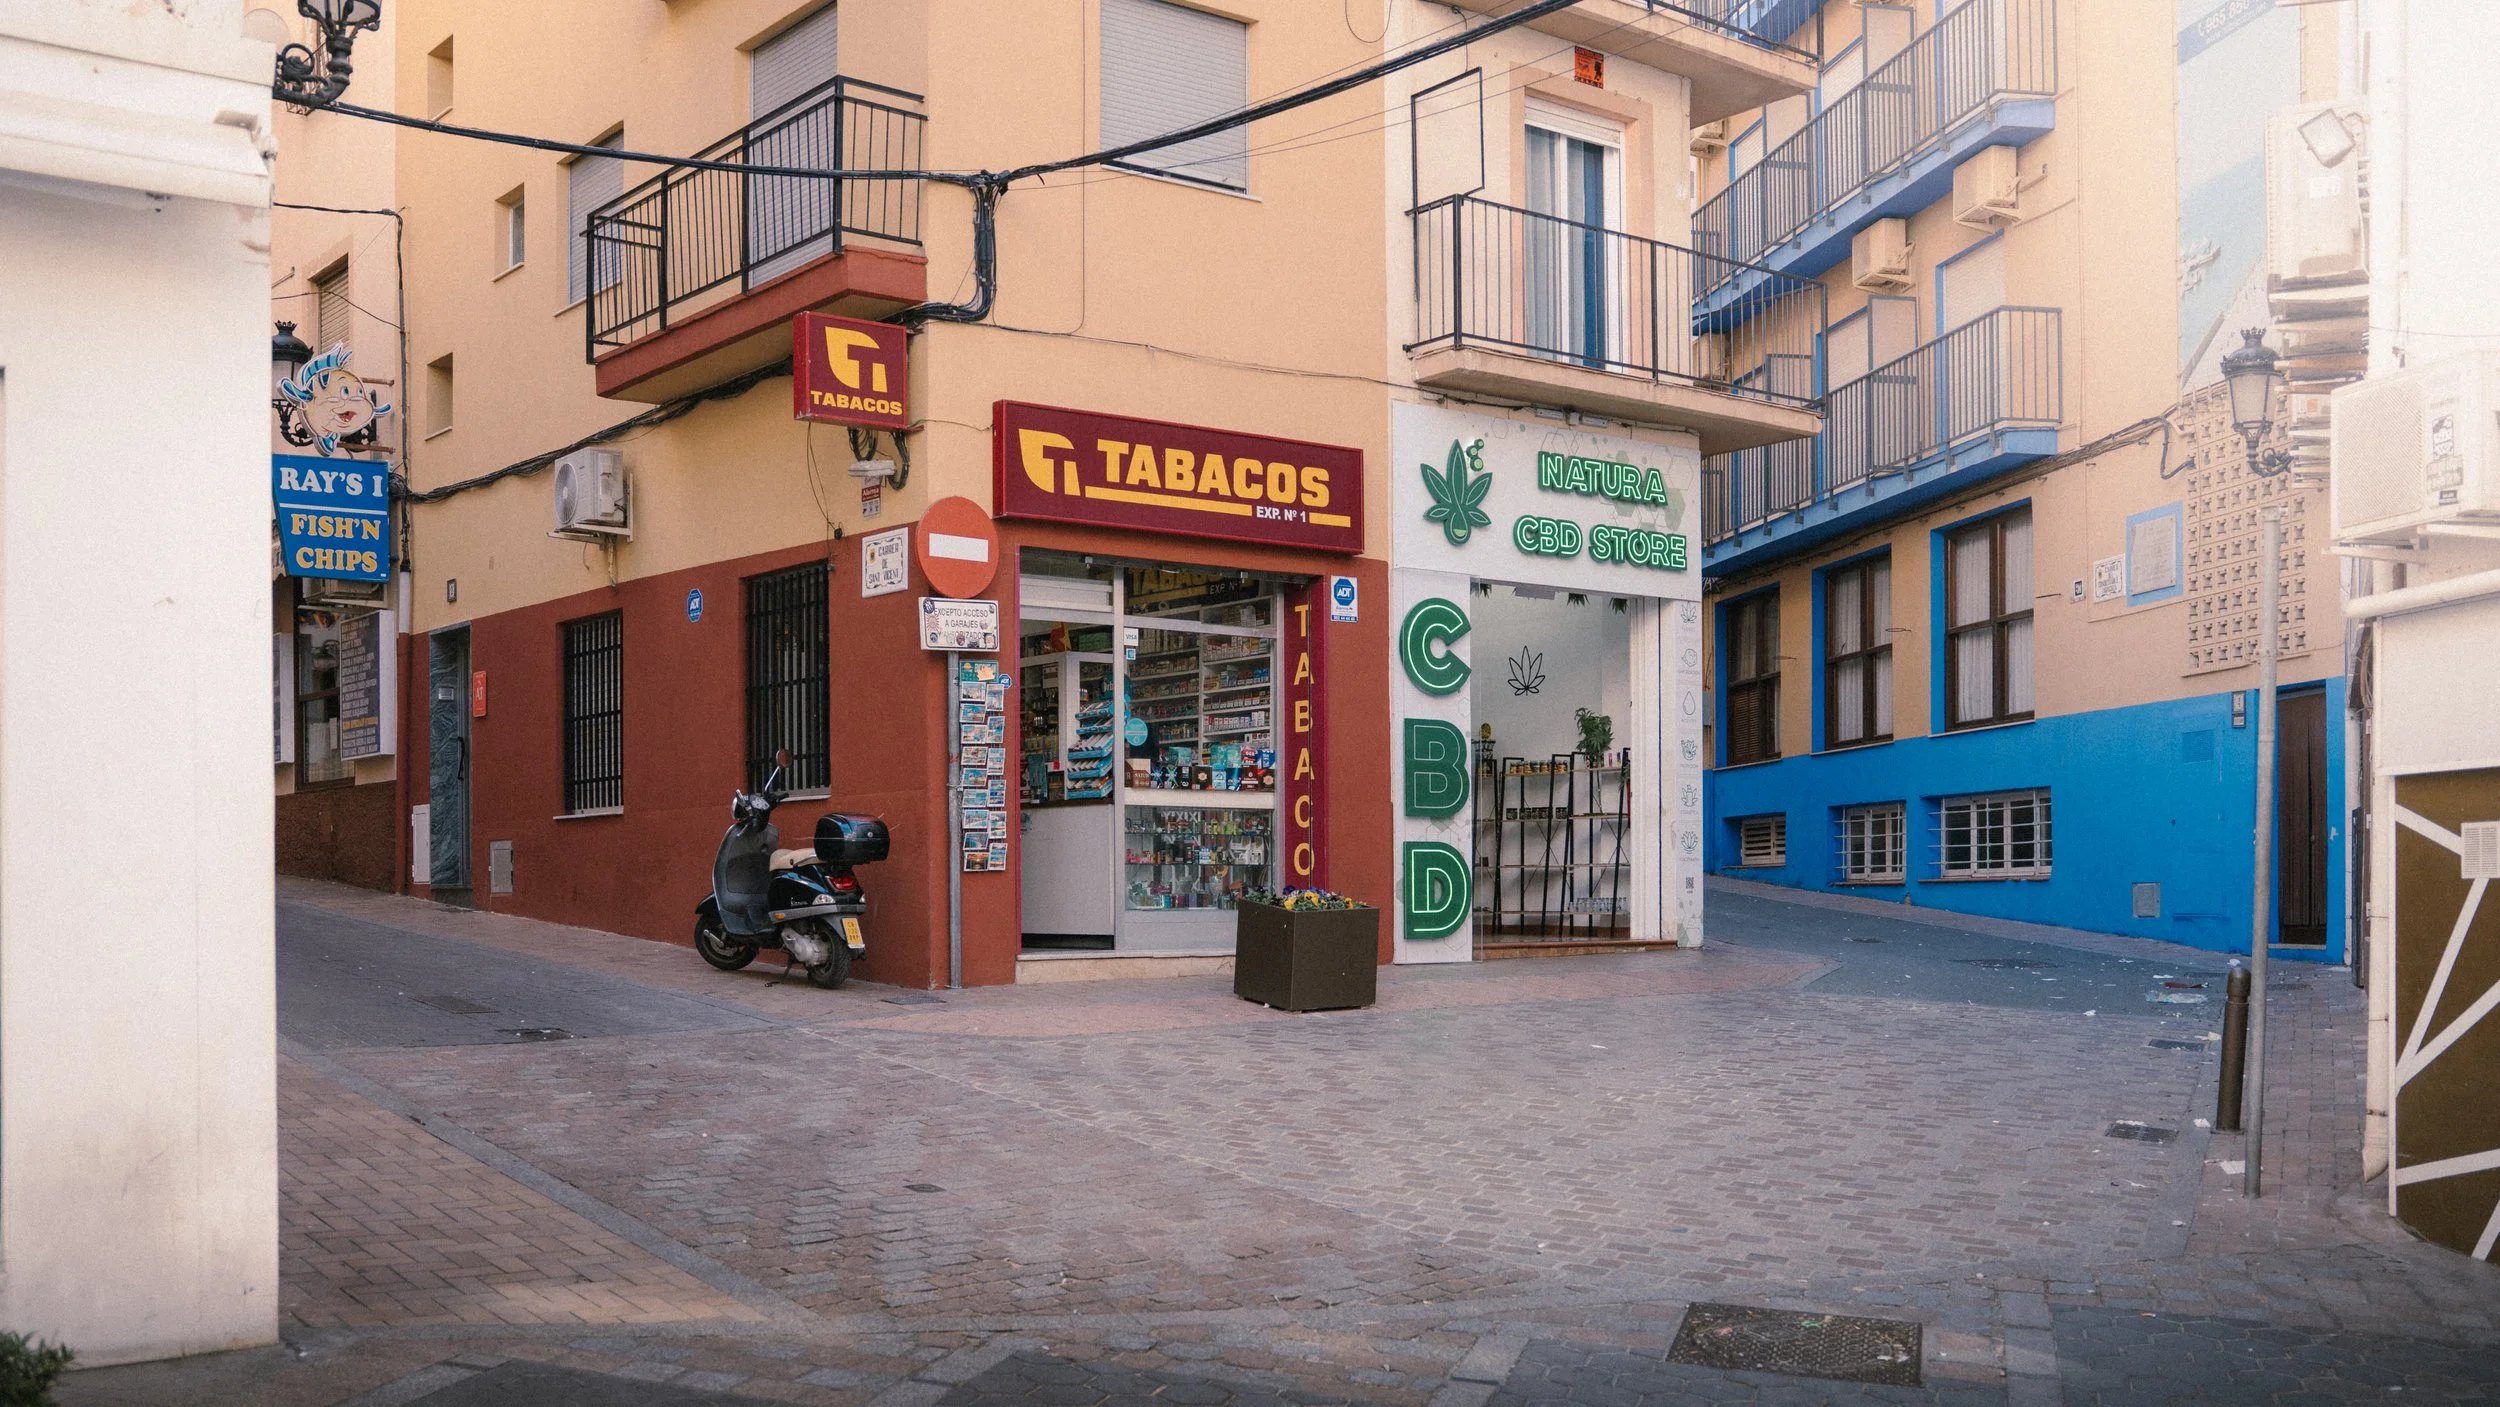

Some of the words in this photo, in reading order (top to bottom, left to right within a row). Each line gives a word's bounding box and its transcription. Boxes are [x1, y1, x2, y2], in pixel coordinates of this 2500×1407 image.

[810, 390, 903, 416] TABACOS
[279, 467, 363, 496] RAY'S
[1097, 438, 1330, 508] TABACOS
[1537, 450, 1668, 507] NATURA
[290, 513, 381, 541] FISH'N
[1256, 505, 1281, 521] EXP.
[1299, 510, 1307, 524] 1
[878, 543, 899, 557] CARRER
[1513, 514, 1583, 558] CBD
[1588, 522, 1688, 571] STORE
[295, 546, 378, 573] CHIPS
[1336, 587, 1352, 598] ADT
[934, 607, 962, 617] EXCEPTO
[963, 608, 989, 618] ACCESO
[944, 619, 950, 628] A
[950, 619, 979, 628] GARAJES
[1399, 597, 1472, 940] CBD
